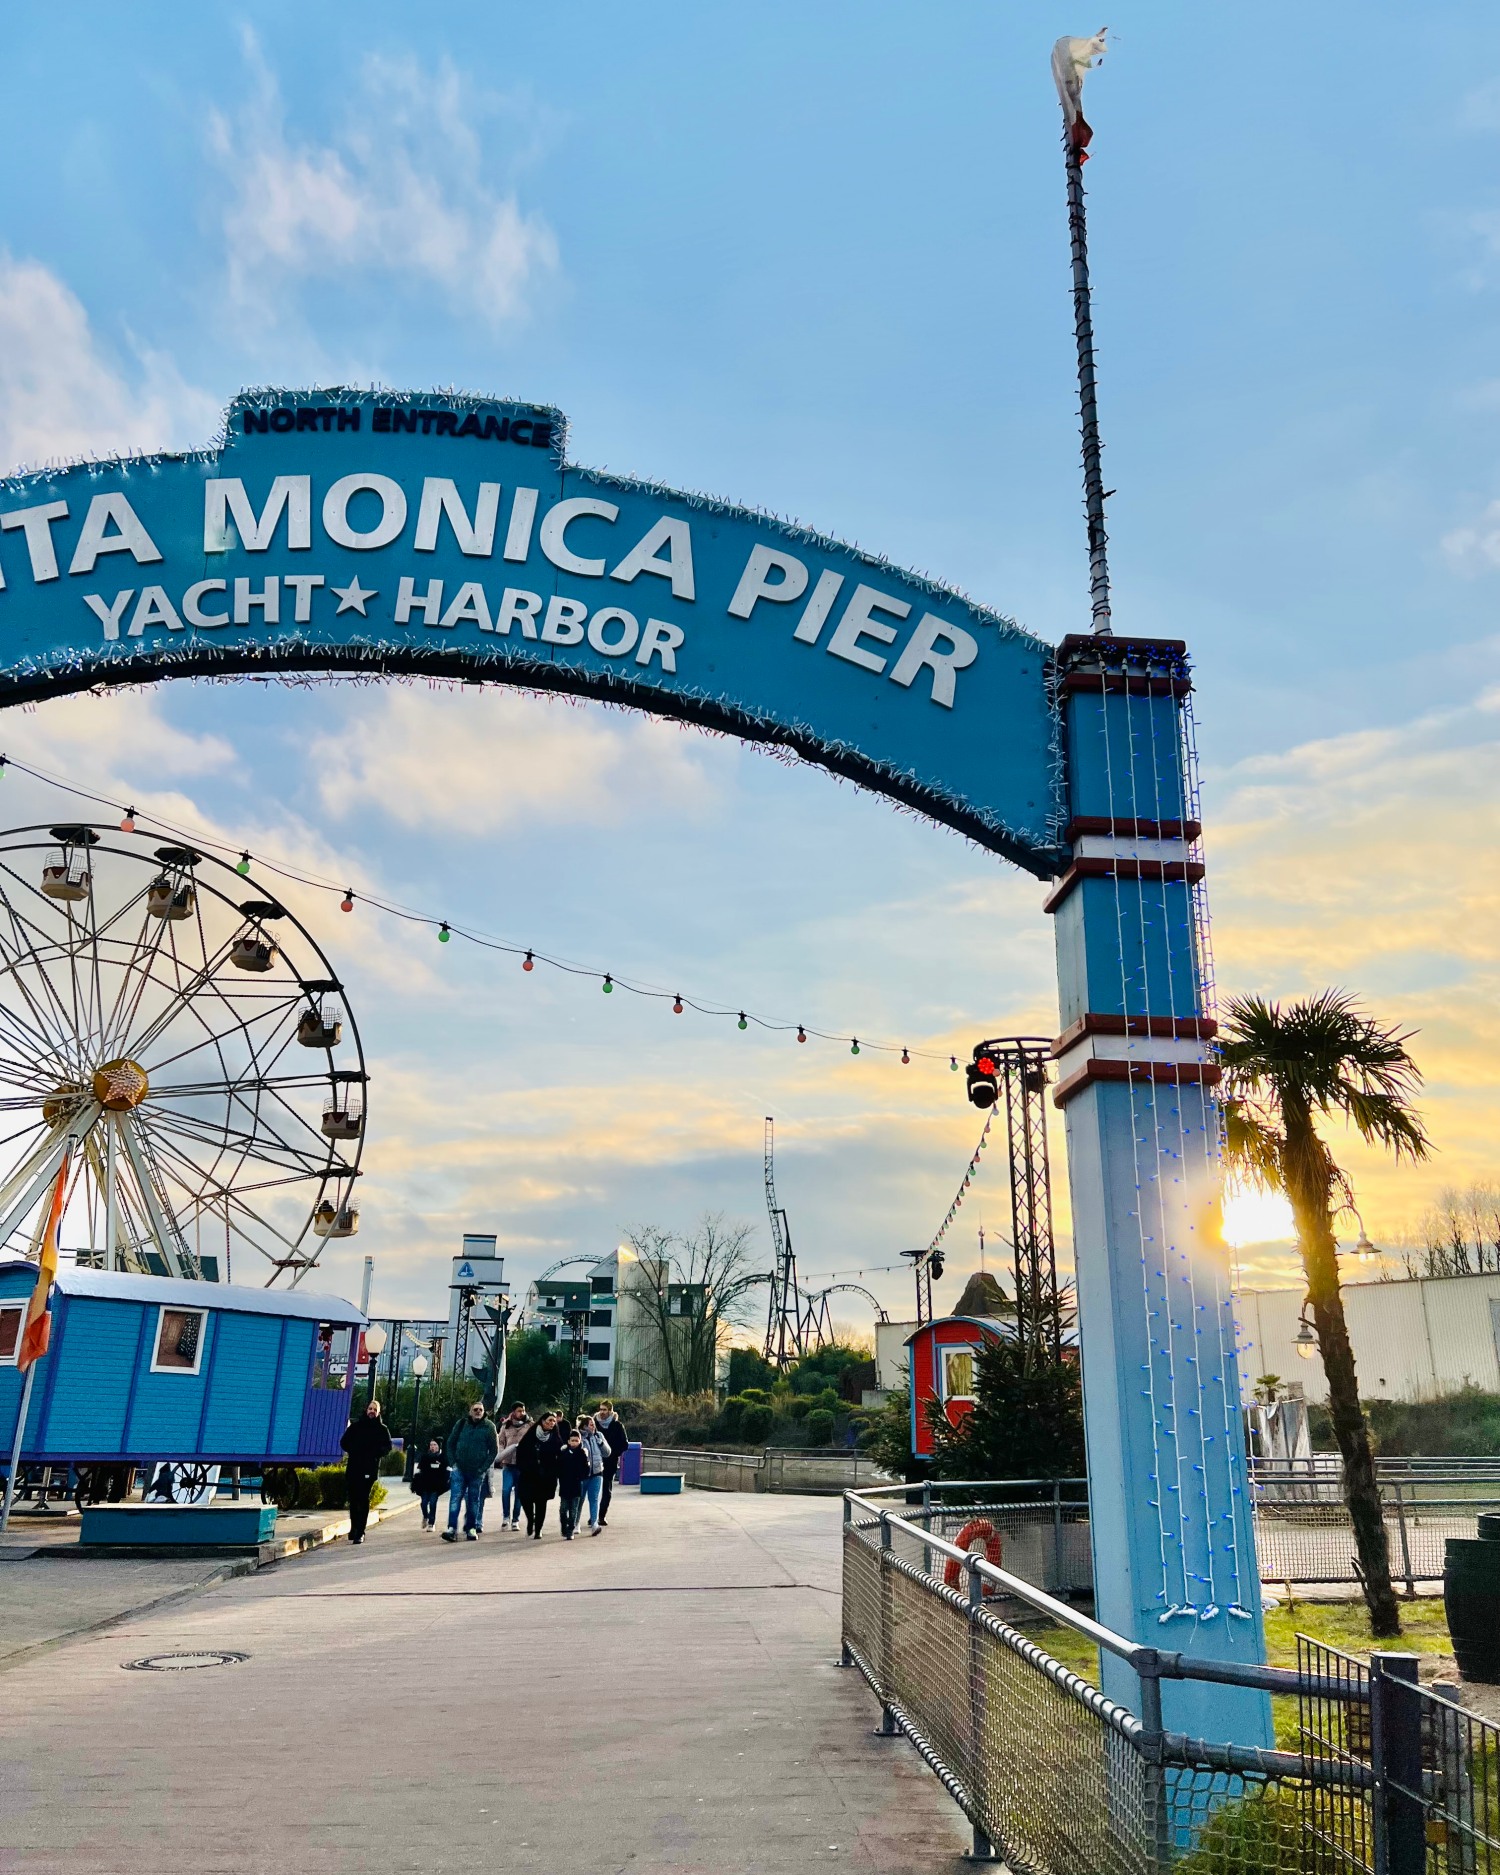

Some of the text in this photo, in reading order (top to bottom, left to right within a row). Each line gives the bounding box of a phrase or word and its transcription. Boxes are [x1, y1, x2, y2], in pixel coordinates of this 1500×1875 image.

[243, 407, 551, 448] NORTH ENTRANCE
[0, 472, 979, 709] TA MONICA PIER
[82, 574, 685, 673] YACHT HARBOR
